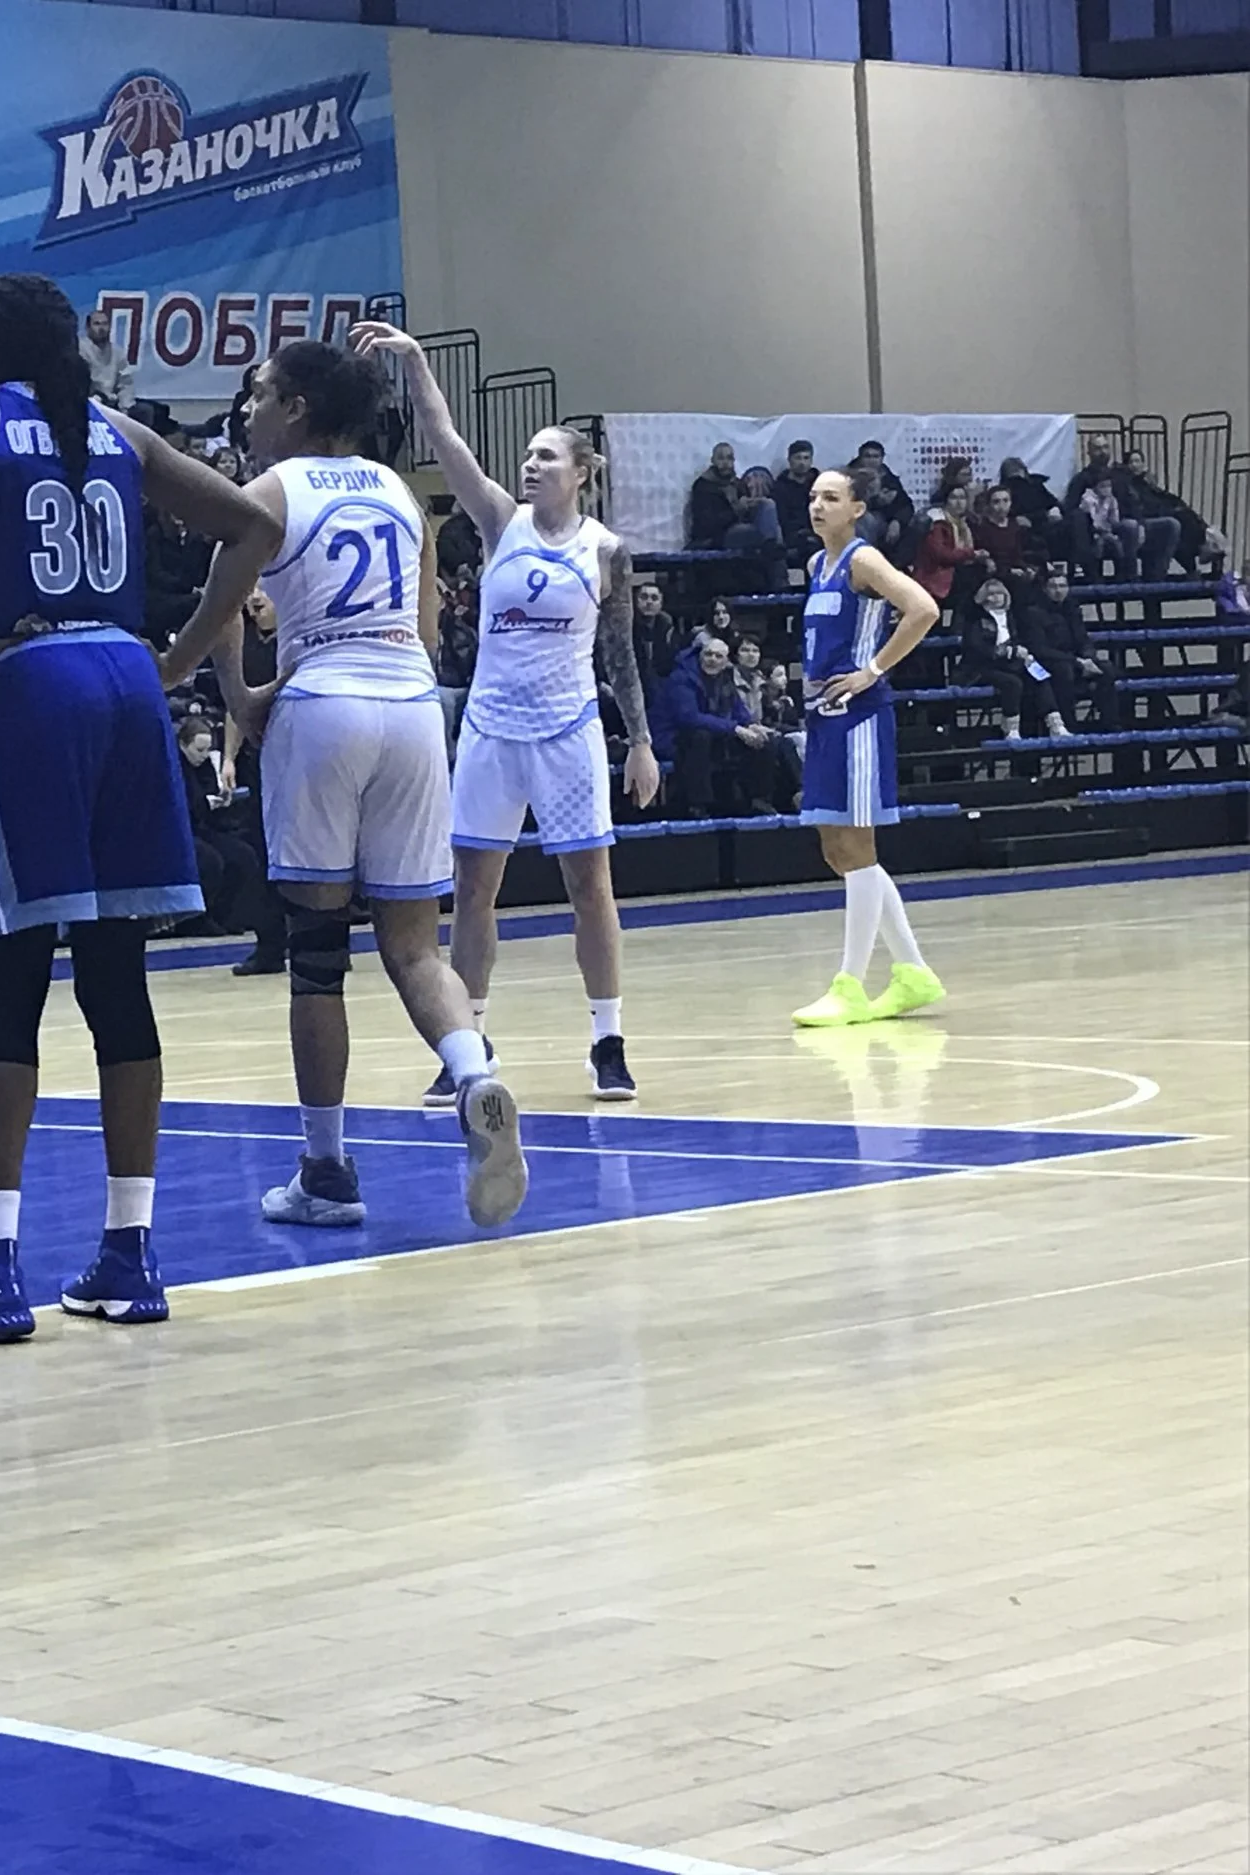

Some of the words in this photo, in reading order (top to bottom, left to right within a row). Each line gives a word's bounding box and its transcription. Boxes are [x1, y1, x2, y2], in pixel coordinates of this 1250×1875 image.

[56, 98, 340, 220] КАЗАНОЧКА
[306, 469, 385, 492] БЕРДИК
[26, 479, 127, 594] 30
[325, 522, 403, 618] 21
[527, 569, 549, 603] 9
